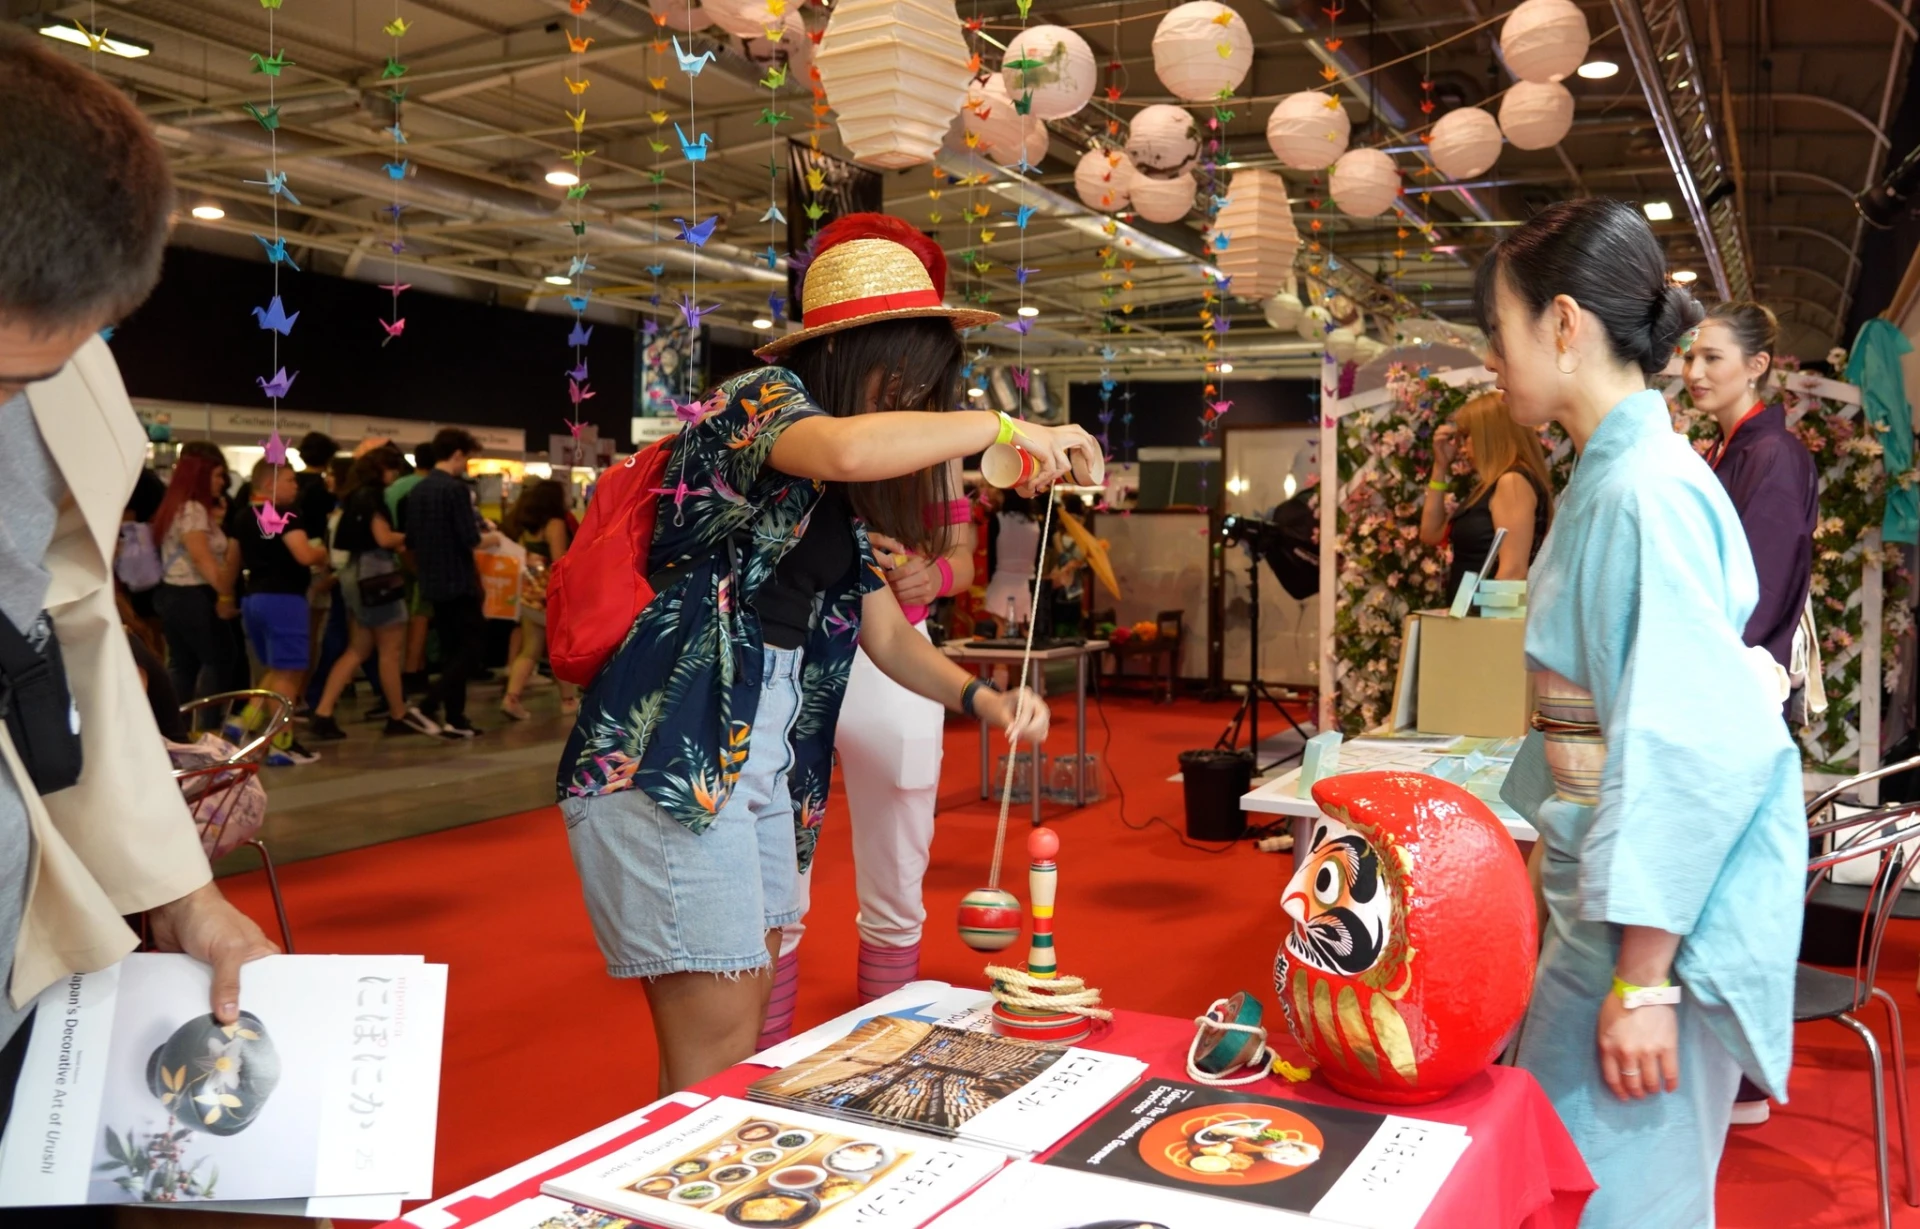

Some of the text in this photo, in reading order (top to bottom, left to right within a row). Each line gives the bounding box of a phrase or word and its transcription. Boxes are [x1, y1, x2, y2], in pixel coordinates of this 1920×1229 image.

[66, 972, 86, 1015] Japan's
[55, 1018, 79, 1085] Decorative
[349, 976, 393, 1129] にぽにか
[51, 1089, 67, 1109] Art
[1130, 1085, 1172, 1114] Experience
[1158, 1088, 1188, 1107] Tokyo:
[48, 1112, 62, 1126] of
[1146, 1106, 1168, 1117] The
[680, 1114, 724, 1137] Healthy
[1117, 1116, 1155, 1140] Ultimate
[40, 1130, 61, 1174] Urushi
[642, 1136, 684, 1156] Eating
[1086, 1139, 1126, 1164] Gourmet
[596, 1161, 632, 1179] Japan
